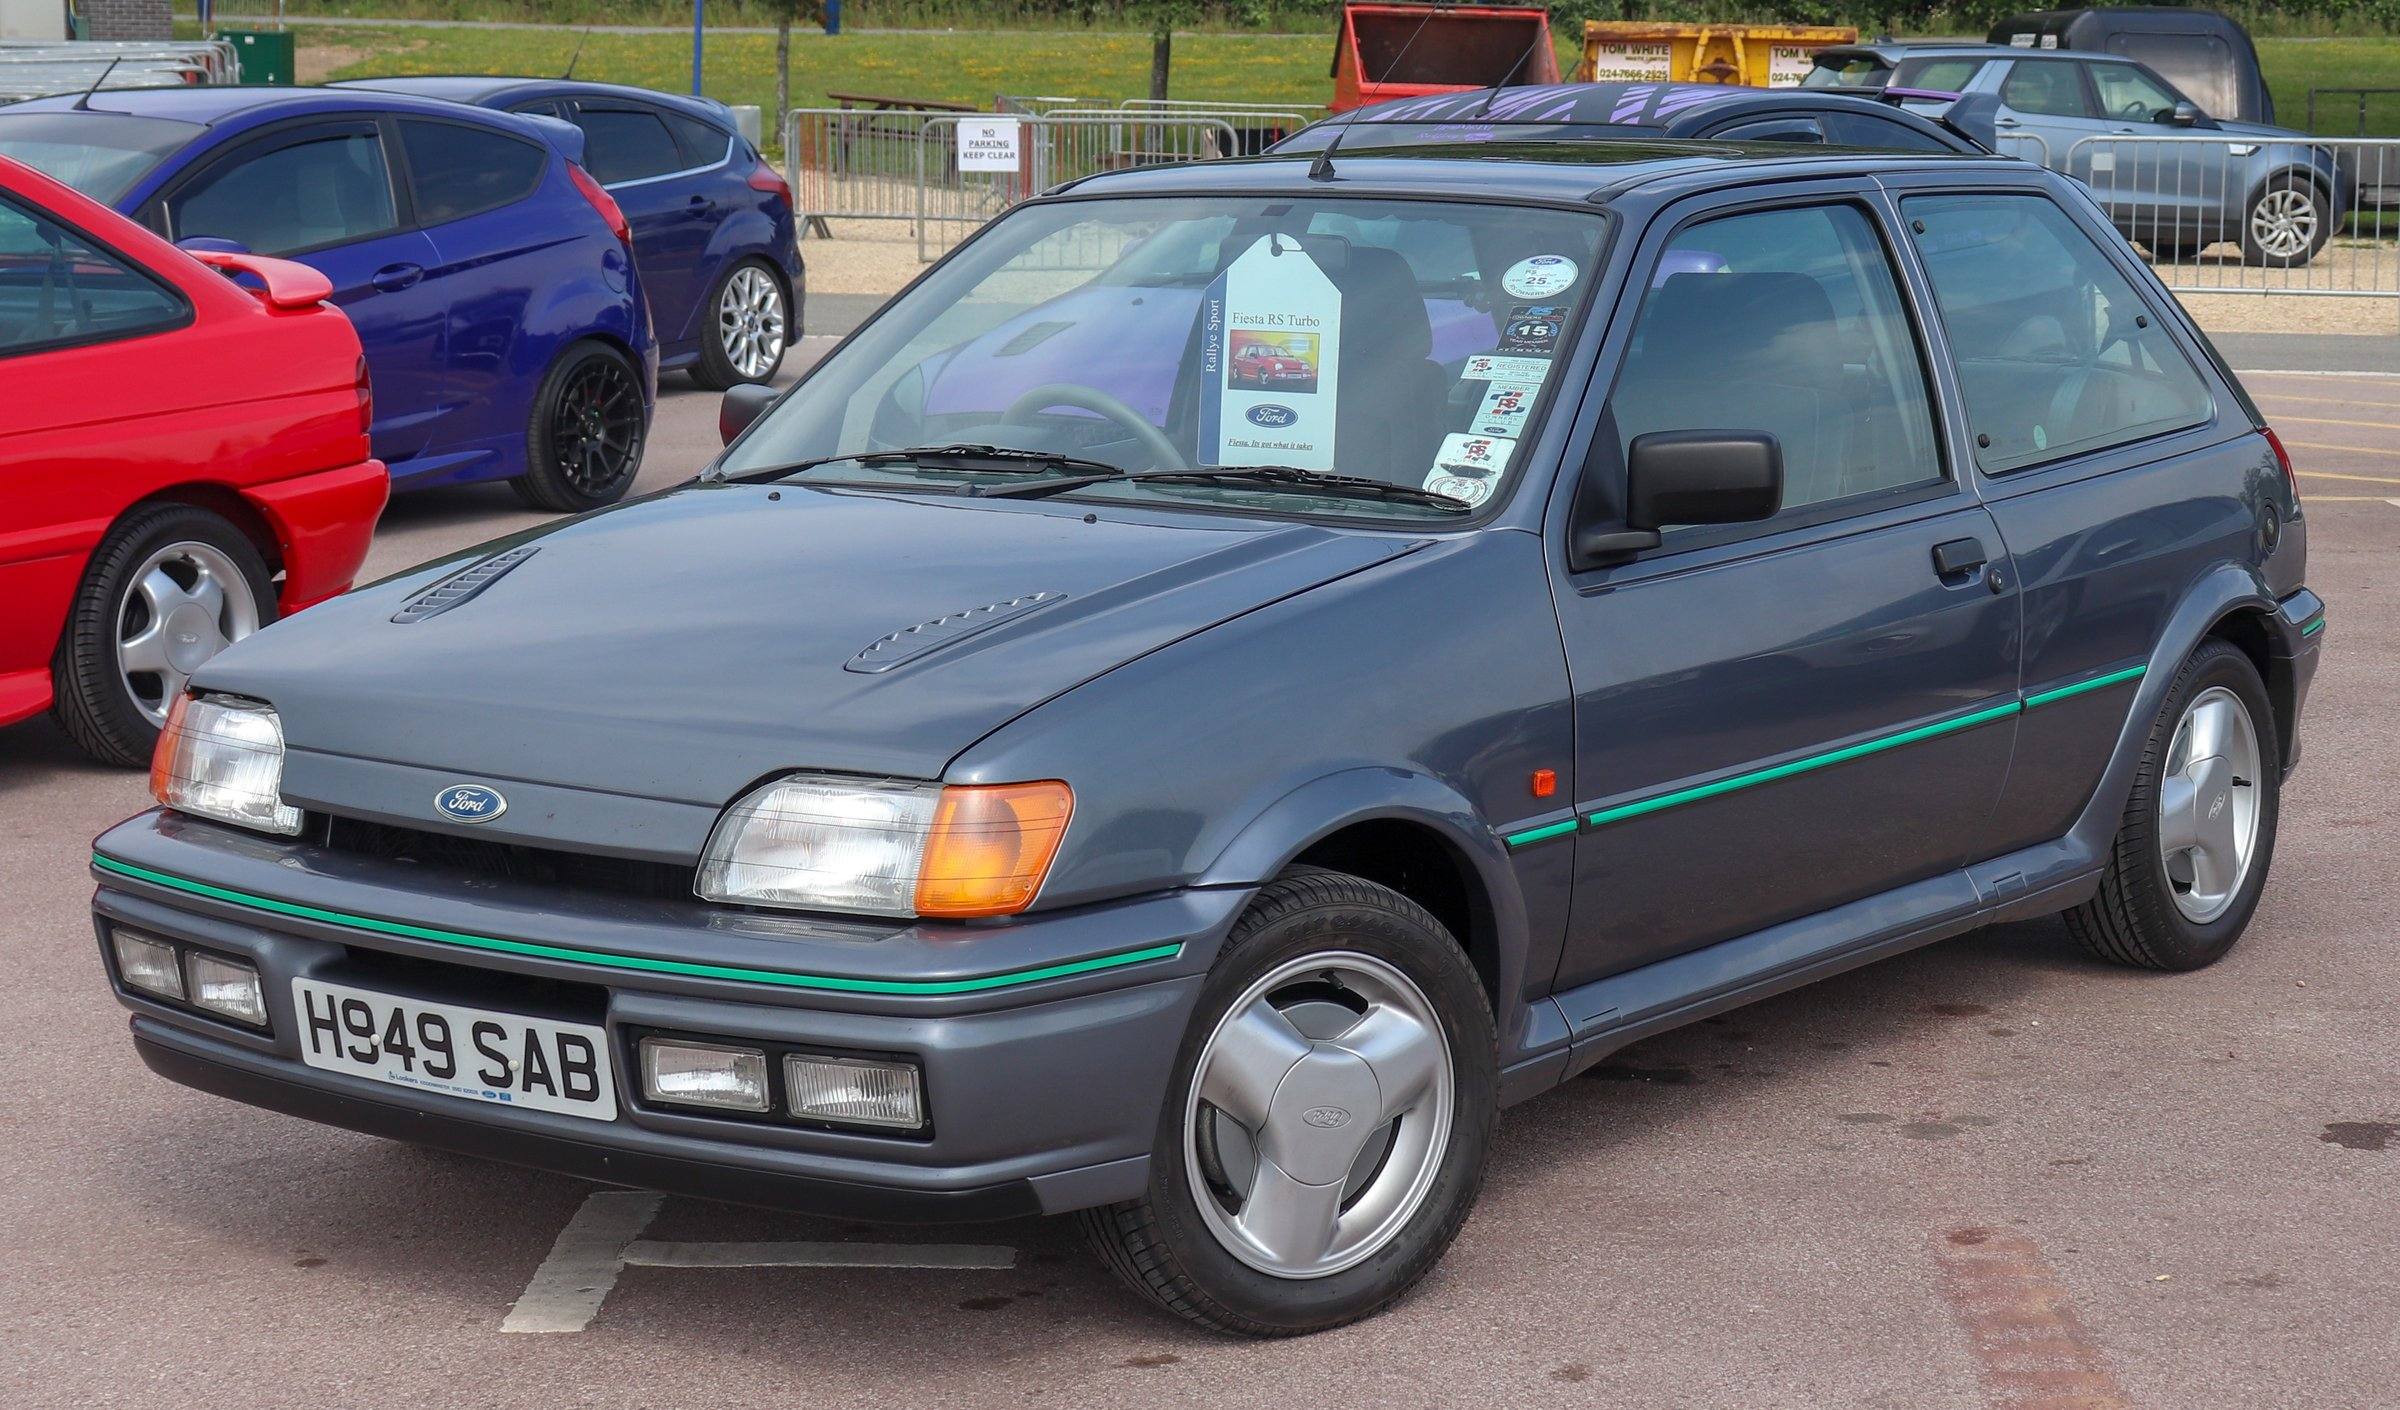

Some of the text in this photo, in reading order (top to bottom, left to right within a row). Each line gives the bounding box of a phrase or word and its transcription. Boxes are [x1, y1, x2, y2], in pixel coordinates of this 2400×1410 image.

[1601, 44, 1669, 55] TOM WHITE
[1773, 48, 1799, 57] TOM
[982, 128, 995, 137] NO
[968, 140, 1009, 148] PARKING
[963, 151, 1016, 159] KEEP CLEAR
[1525, 277, 1548, 285] 25
[1232, 312, 1320, 327] Fiesta RS Turbo
[1206, 299, 1221, 372] Rallye Sport
[1518, 325, 1549, 336] 15
[1256, 407, 1288, 424] Ford
[448, 789, 488, 811] Ford
[304, 990, 600, 1102] H949 SAB
